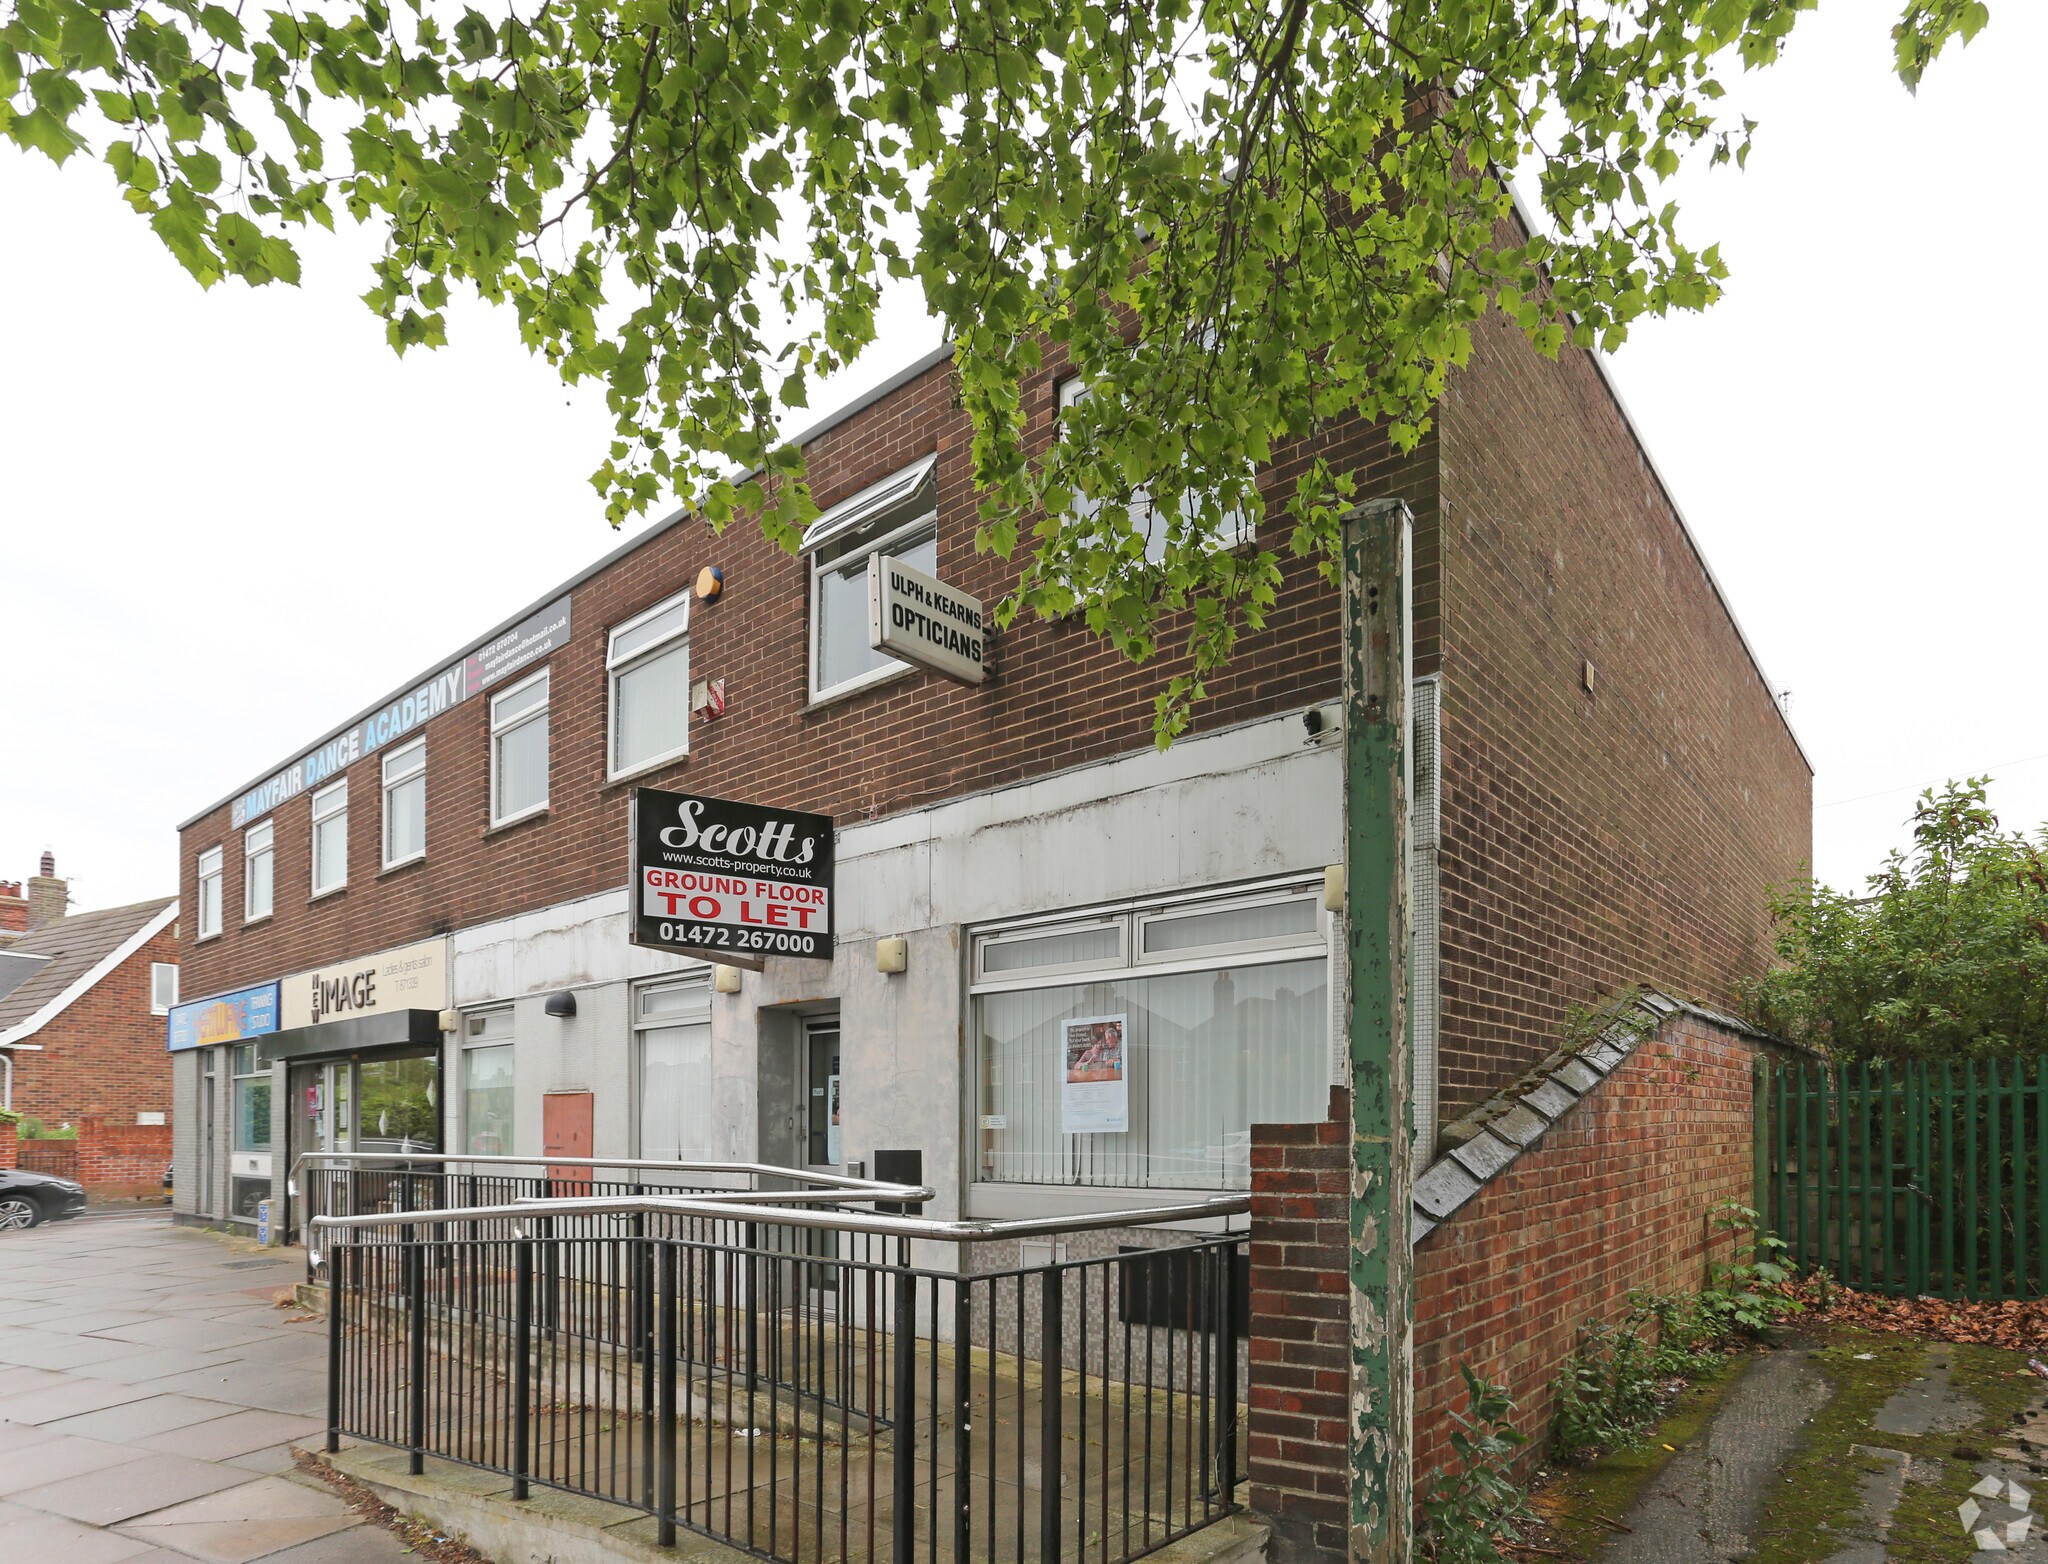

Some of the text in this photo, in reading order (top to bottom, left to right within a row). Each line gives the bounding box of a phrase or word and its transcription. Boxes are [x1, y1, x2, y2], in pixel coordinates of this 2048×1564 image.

[891, 571, 981, 630] ULPH & KEARNS
[478, 645, 496, 662] 01472
[485, 616, 567, 671] mayfairdance@hotmail.co.uk
[892, 602, 981, 662] OPTICIANS
[482, 638, 552, 686] www.mayfairdance.co.uk
[246, 667, 462, 820] MAYFAIR DANCE ACADEMY
[659, 800, 815, 864] Scotts
[646, 870, 825, 905] GROUND FLOOR
[662, 852, 812, 879] www.scotts-property.co.uk
[657, 891, 817, 928] TO LET
[659, 922, 815, 953] 01472 267000
[382, 963, 399, 977] Ladies
[404, 958, 418, 975] gents
[418, 956, 432, 969] salon
[311, 973, 320, 1024] NEW
[320, 968, 376, 1015] IMAGE
